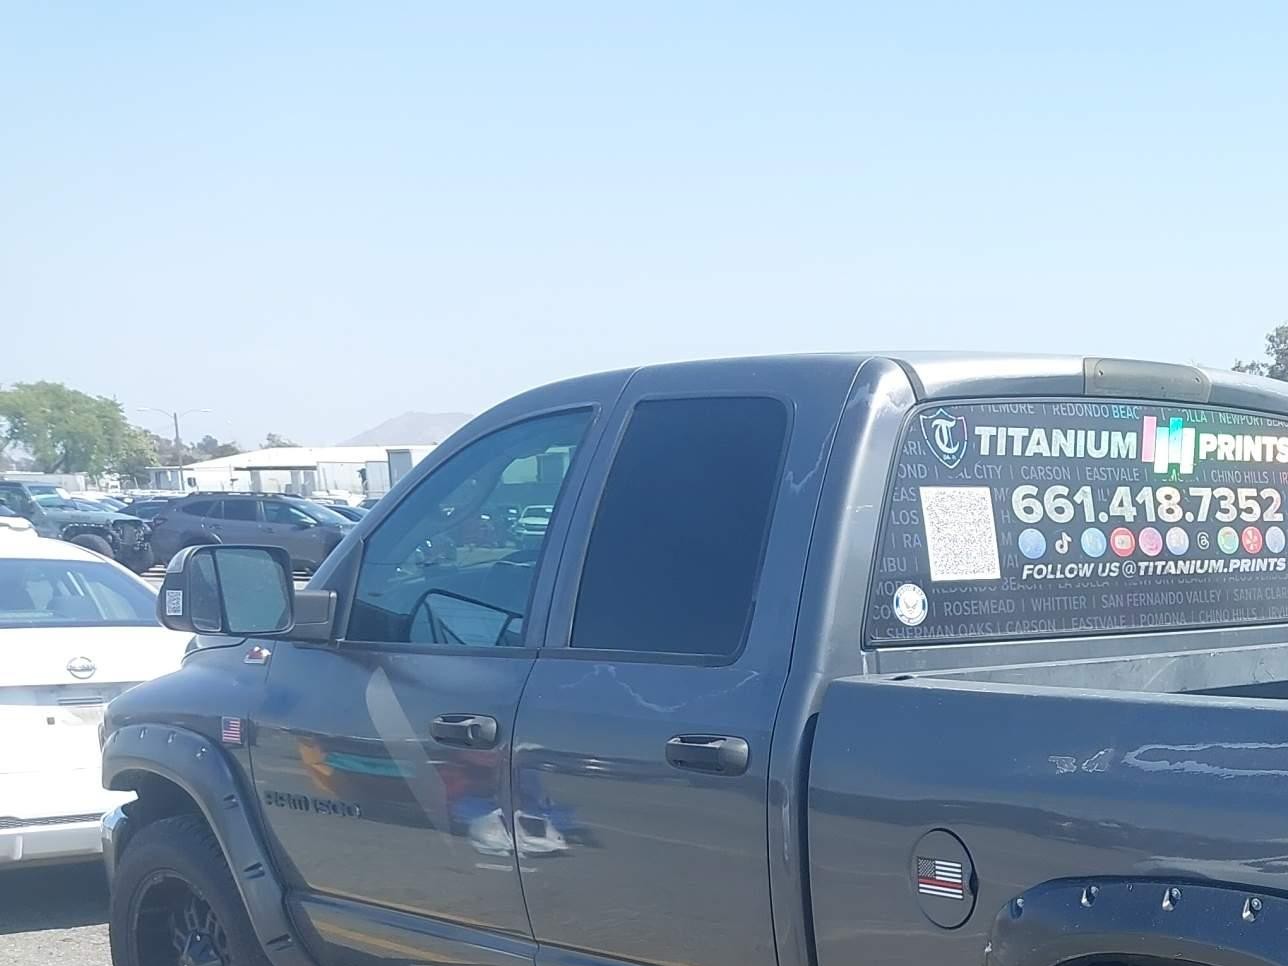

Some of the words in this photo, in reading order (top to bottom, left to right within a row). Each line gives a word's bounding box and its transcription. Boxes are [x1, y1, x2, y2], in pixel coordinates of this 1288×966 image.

[1053, 403, 1108, 418] REDONDO
[1112, 403, 1142, 419] BEAC
[1218, 412, 1263, 427] NEWPORT
[974, 426, 1137, 459] TITANIUM
[974, 463, 1002, 479] CITY
[1021, 466, 1071, 480] CARSON
[1085, 467, 1140, 482] EASTVALE
[1210, 470, 1241, 484] CHINO
[1243, 471, 1269, 484] HILLS
[1011, 485, 1284, 523] 661.418.7352
[1022, 563, 1095, 580] FOLLOW
[1097, 562, 1120, 577] US
[1121, 557, 1287, 578] @TITANIUM.PRINTS
[943, 600, 1016, 617] ROSEMEAD
[1031, 596, 1087, 612] WHITTIER
[1101, 594, 1123, 609] SAN
[1127, 591, 1184, 608] FERNANDO
[1185, 589, 1222, 604] VALLEY
[1233, 587, 1262, 602] SANTA
[886, 625, 954, 640] SHERMAN
[958, 622, 993, 637] OAKS
[1006, 619, 1057, 634] CARSON
[1071, 615, 1127, 632] EASTVALE
[1140, 612, 1186, 627] POMONA
